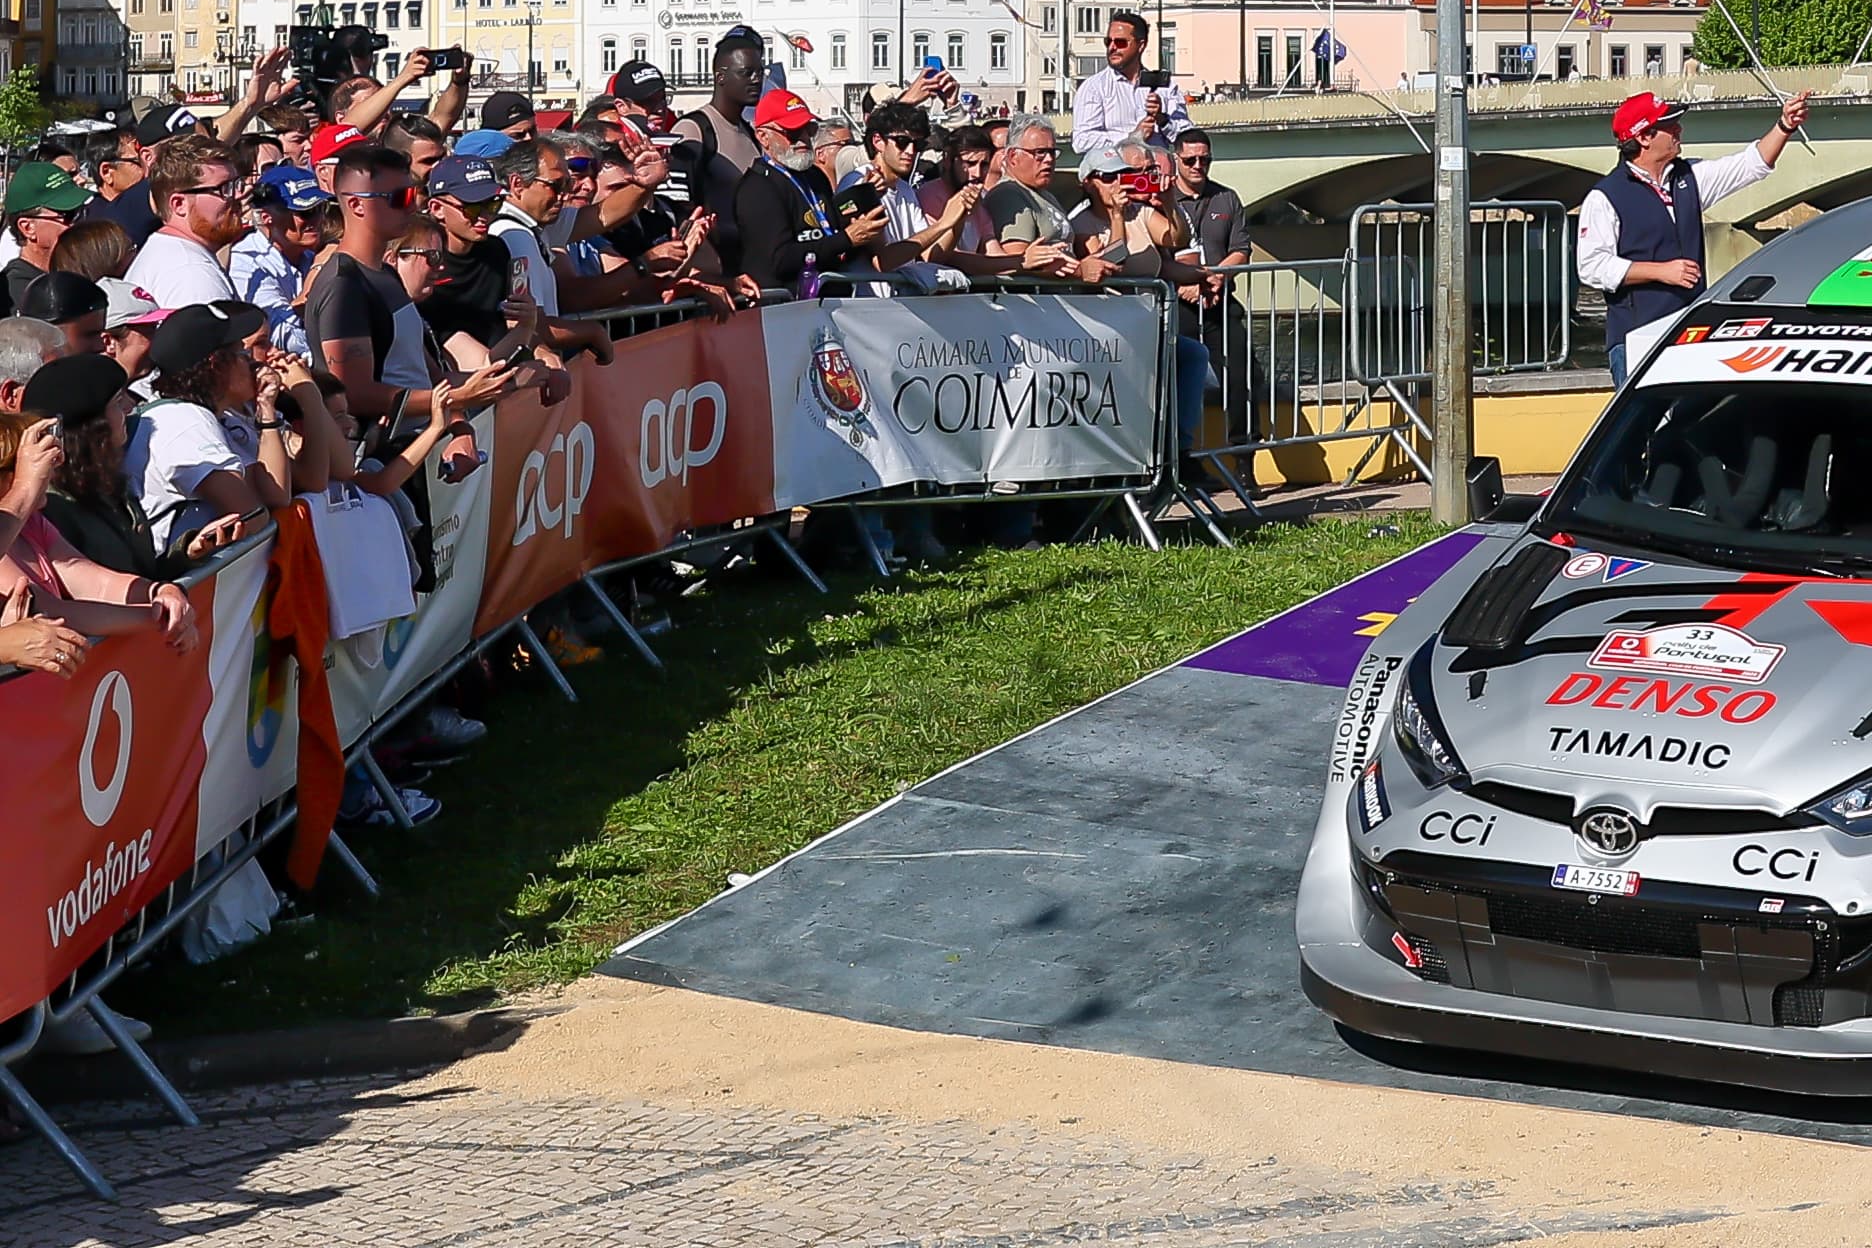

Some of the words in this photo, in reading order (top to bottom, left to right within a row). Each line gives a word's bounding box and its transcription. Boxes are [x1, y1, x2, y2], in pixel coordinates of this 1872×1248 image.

[475, 19, 501, 28] HOTEL
[898, 335, 993, 370] CÂMARA
[999, 335, 1123, 365] MUNICIPAL
[1006, 366, 1022, 380] DE
[893, 369, 1123, 436] COIMBRA
[640, 380, 728, 490] acp
[512, 421, 595, 548] acp
[1662, 639, 1697, 652] rally
[1699, 643, 1718, 652] de
[1685, 628, 1715, 641] 33
[1653, 646, 1752, 665] Portugal
[1330, 652, 1380, 783] AUTOMOTIVE
[1544, 671, 1779, 725] DENSO
[1350, 656, 1403, 781] Panasonic
[1549, 727, 1732, 770] TAMADIC
[1419, 810, 1497, 847] CCi
[1570, 871, 1623, 890] A-7552
[1732, 843, 1819, 882] CCi
[47, 828, 153, 949] vodafone
